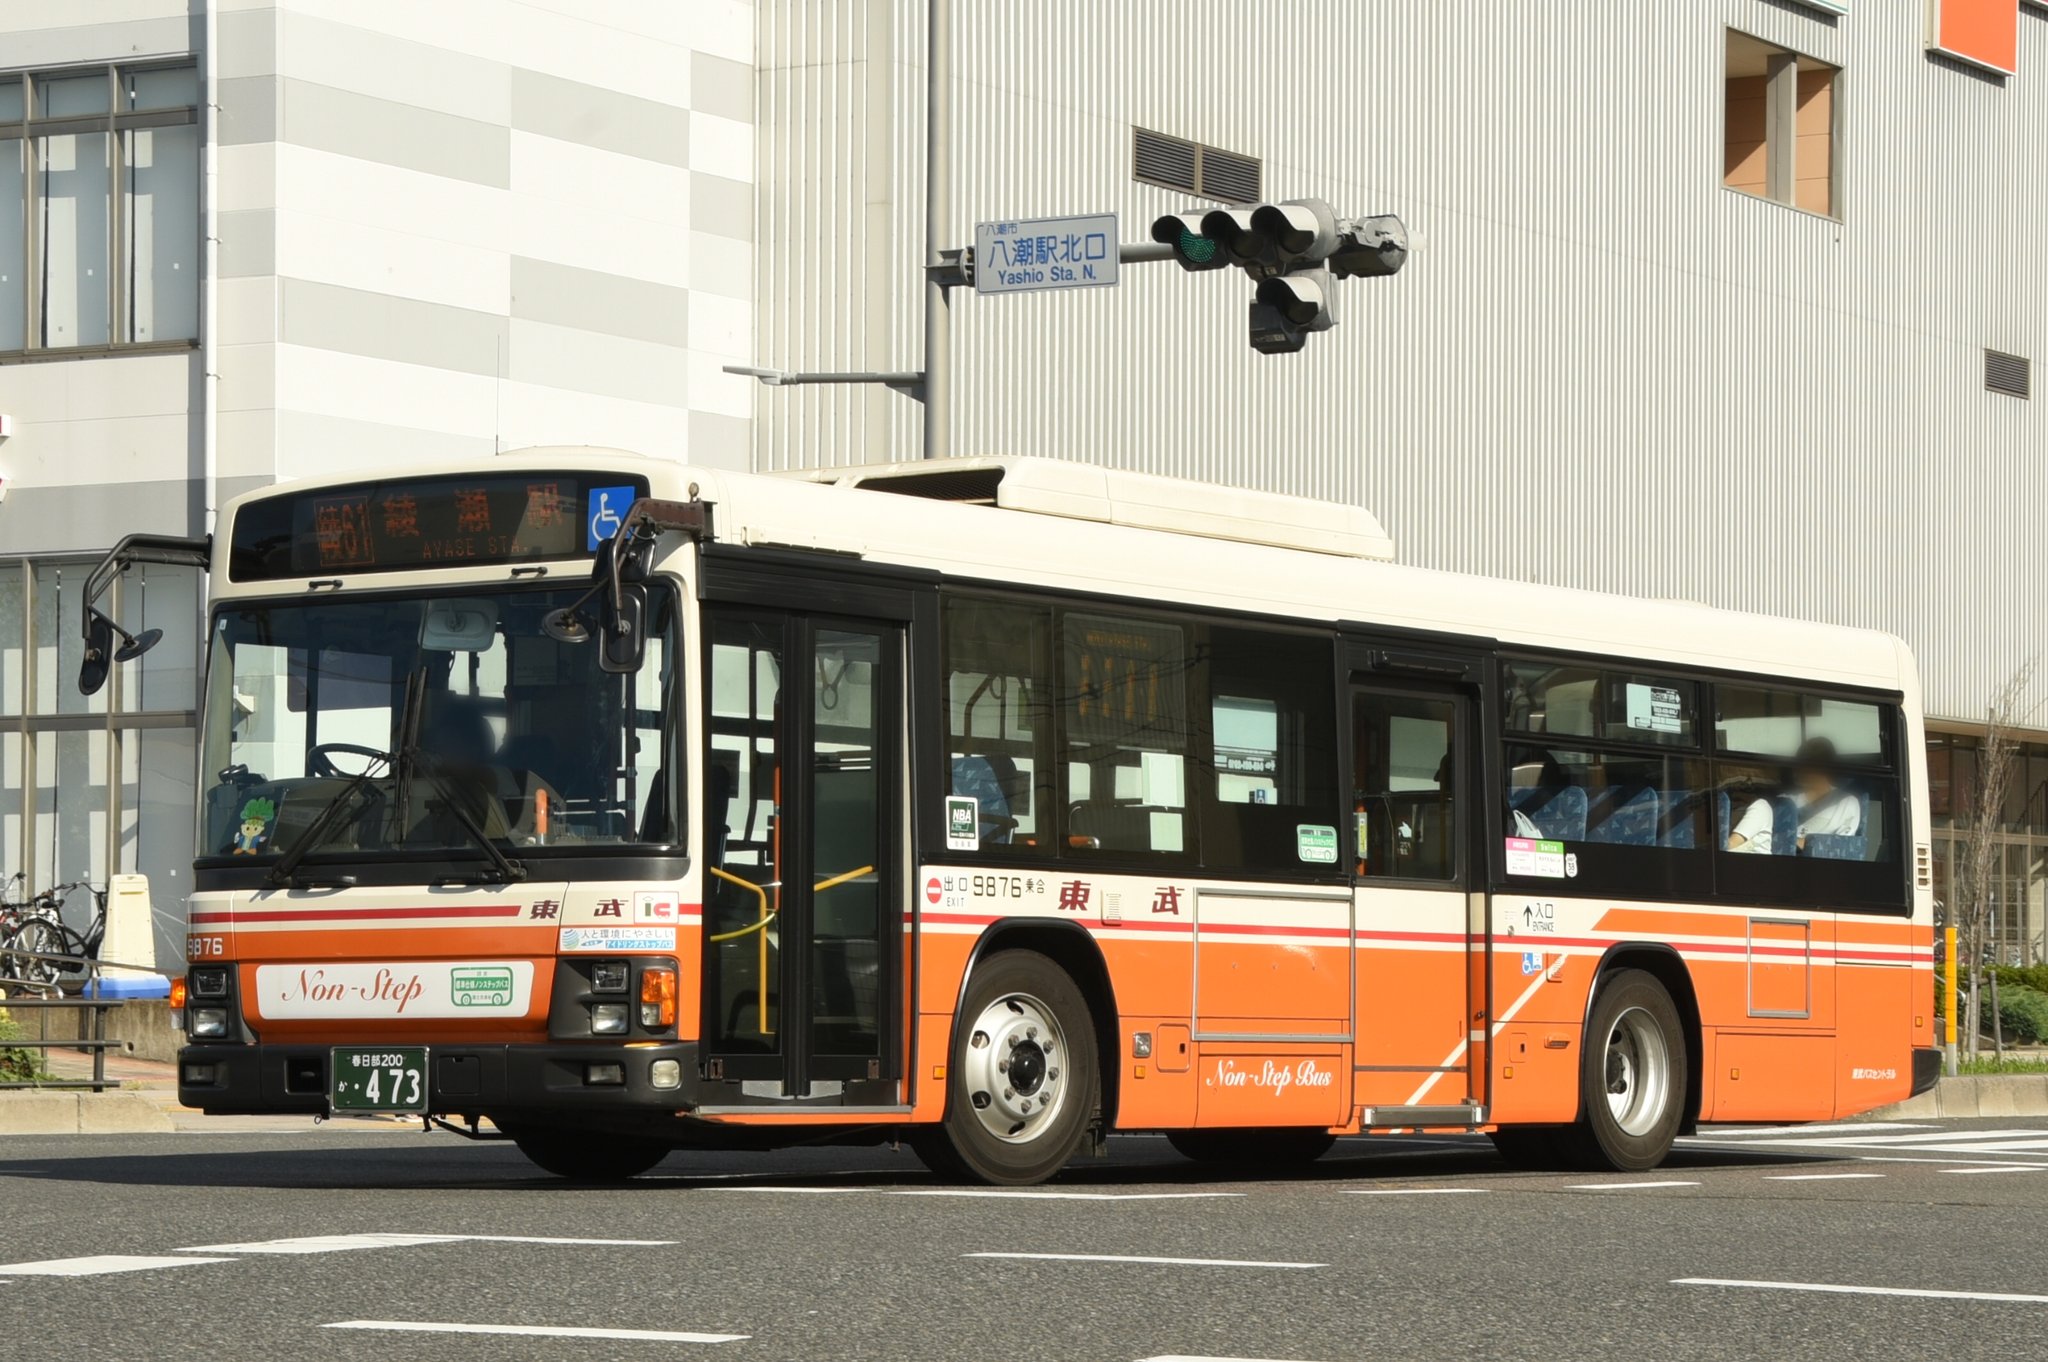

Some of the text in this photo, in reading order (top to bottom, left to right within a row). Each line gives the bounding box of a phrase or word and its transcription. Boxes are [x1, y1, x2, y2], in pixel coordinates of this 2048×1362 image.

[985, 223, 1018, 236] 八潮市
[988, 233, 1106, 268] 八潮駅北口
[998, 264, 1097, 285] Yashio Sta. N.
[422, 537, 476, 559] AYASE
[952, 808, 972, 822] NBA
[944, 876, 968, 892] 出口
[973, 875, 1022, 898] 9876
[946, 896, 965, 907] EXIT
[1535, 902, 1554, 919] 入口
[581, 928, 673, 939] 人と環境にやさしい
[1532, 920, 1555, 933] ENTRANCE
[187, 937, 224, 956] 9876
[281, 968, 426, 1014] Non-Step
[1206, 1059, 1333, 1097] Non-Step Bus
